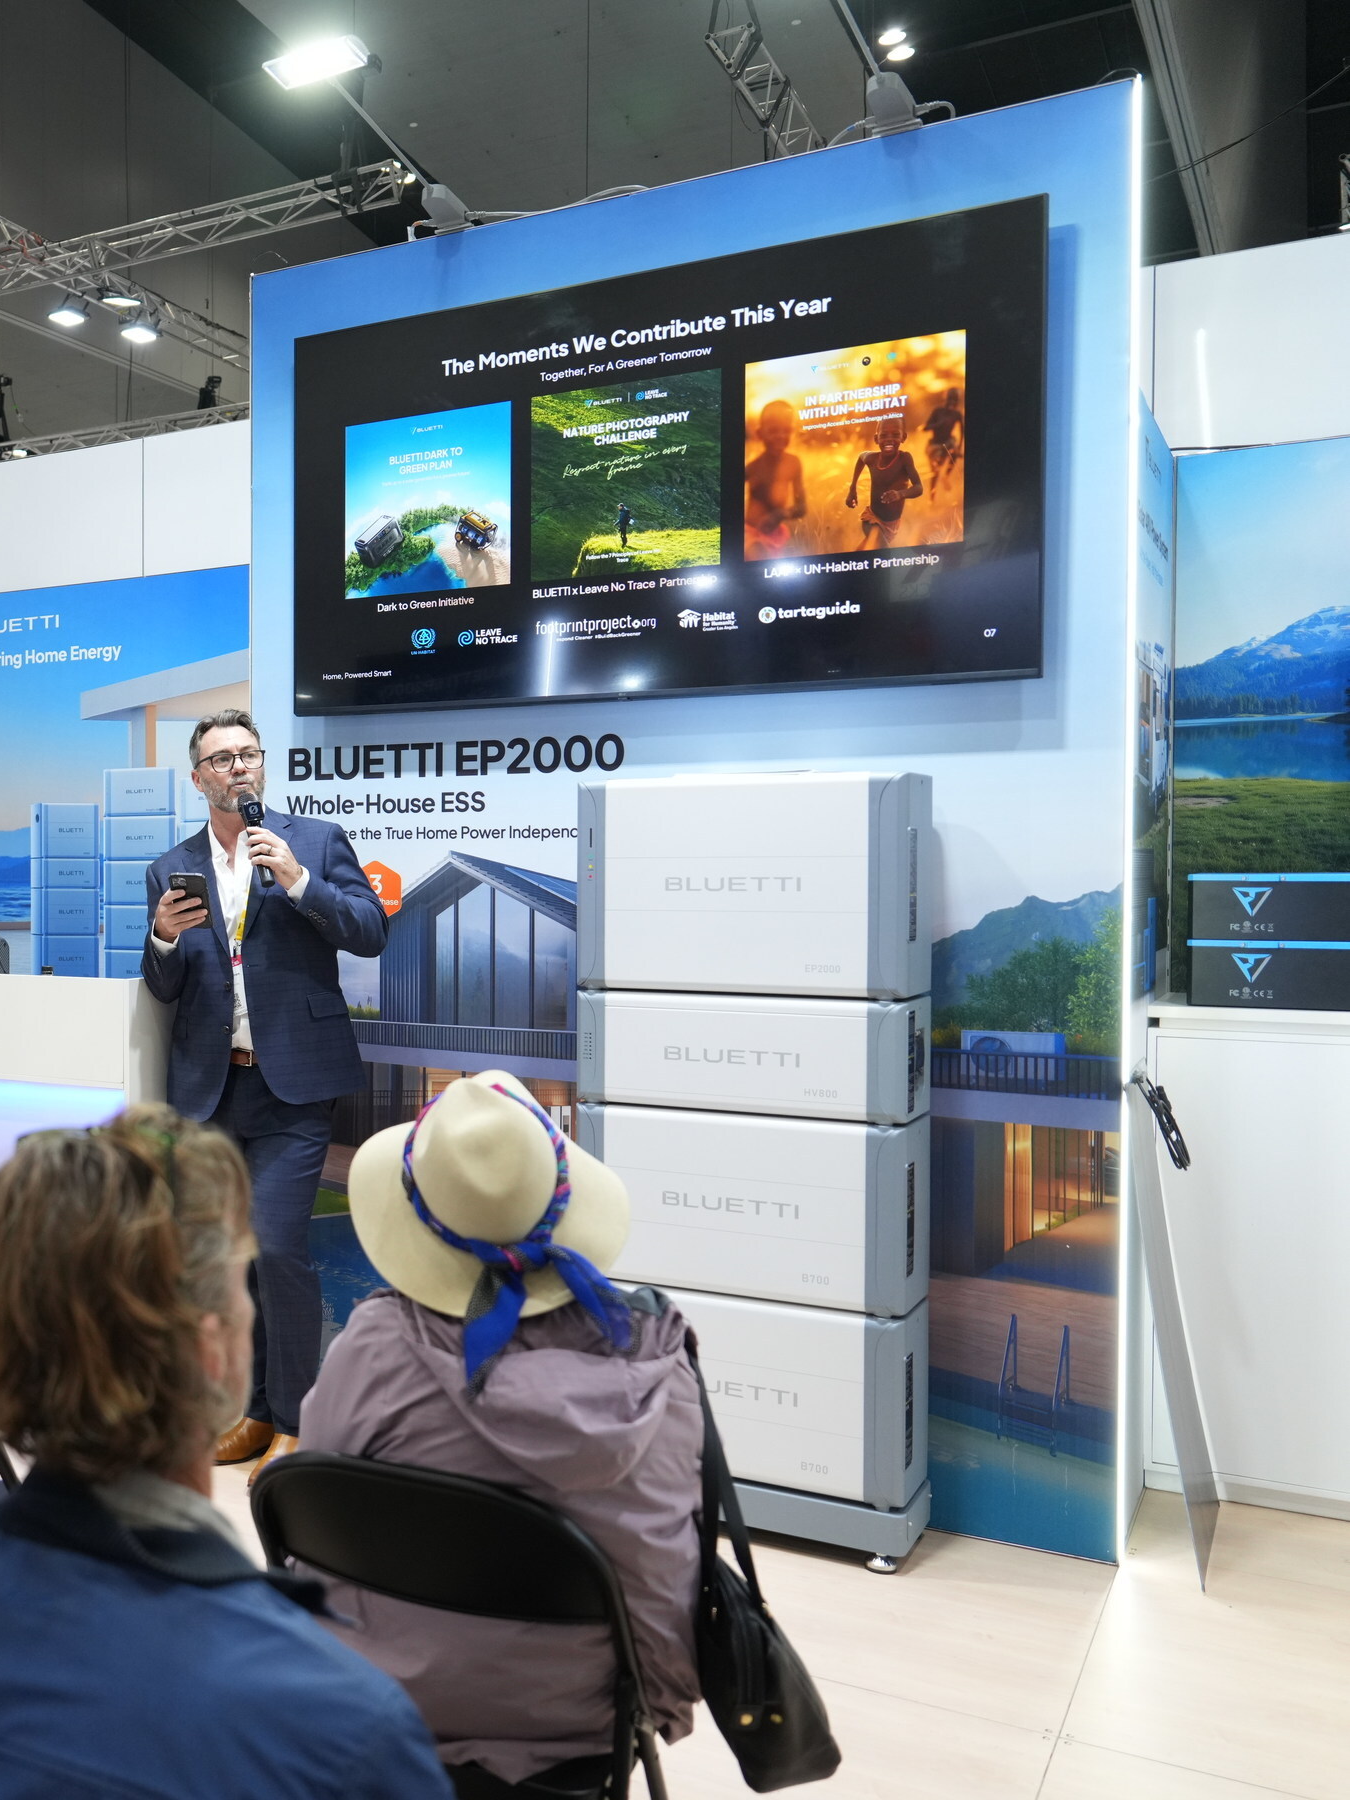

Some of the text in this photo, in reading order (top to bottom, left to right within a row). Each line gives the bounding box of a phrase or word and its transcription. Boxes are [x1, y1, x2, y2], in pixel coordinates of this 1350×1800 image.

[442, 297, 832, 377] The Moments We Contribute This Year
[540, 346, 712, 382] Together, For A Greener Tomorrow
[592, 397, 623, 406] BLUETTI
[805, 383, 901, 407] IN PARTNERSHIP
[799, 395, 908, 420] WITH UN-HABITAT
[562, 411, 690, 439] NATURE PHOTOGRAPHY
[593, 428, 657, 446] CHALLENGE
[389, 446, 463, 466] BLUETTI DARK TO
[399, 459, 453, 475] GREEN PLAN
[804, 553, 940, 575] UN-Habitat Partnership
[532, 586, 571, 599] BLUETTI
[579, 583, 609, 595] Leave
[610, 581, 625, 592] No
[627, 579, 656, 590] Trace
[660, 574, 718, 588] Partnerip
[377, 595, 475, 613] Dark to Green Initiative
[778, 600, 860, 620] tartaguida
[702, 611, 735, 621] Habitat
[475, 627, 502, 638] LEAVE
[475, 634, 518, 645] NO TRACE
[983, 628, 997, 638] 07
[25, 649, 67, 665] Home
[70, 644, 122, 662] Energy
[322, 669, 392, 681] Home, Powered Smart
[287, 733, 625, 782] BLUETTI EP2000
[286, 791, 486, 816] Whole-House ESS
[359, 827, 382, 840] the
[384, 826, 413, 840] True
[416, 826, 458, 840] Home
[460, 826, 506, 840] Power
[369, 873, 383, 895] 3
[664, 876, 802, 892] BLUETTI
[804, 963, 841, 974] EP2000
[663, 1045, 800, 1069] BLUETTI
[803, 1088, 838, 1099] HV800
[661, 1190, 800, 1220] BLUETTI
[801, 1272, 830, 1286] B700
[706, 1380, 799, 1408] UETTI
[800, 1460, 829, 1475] B700
